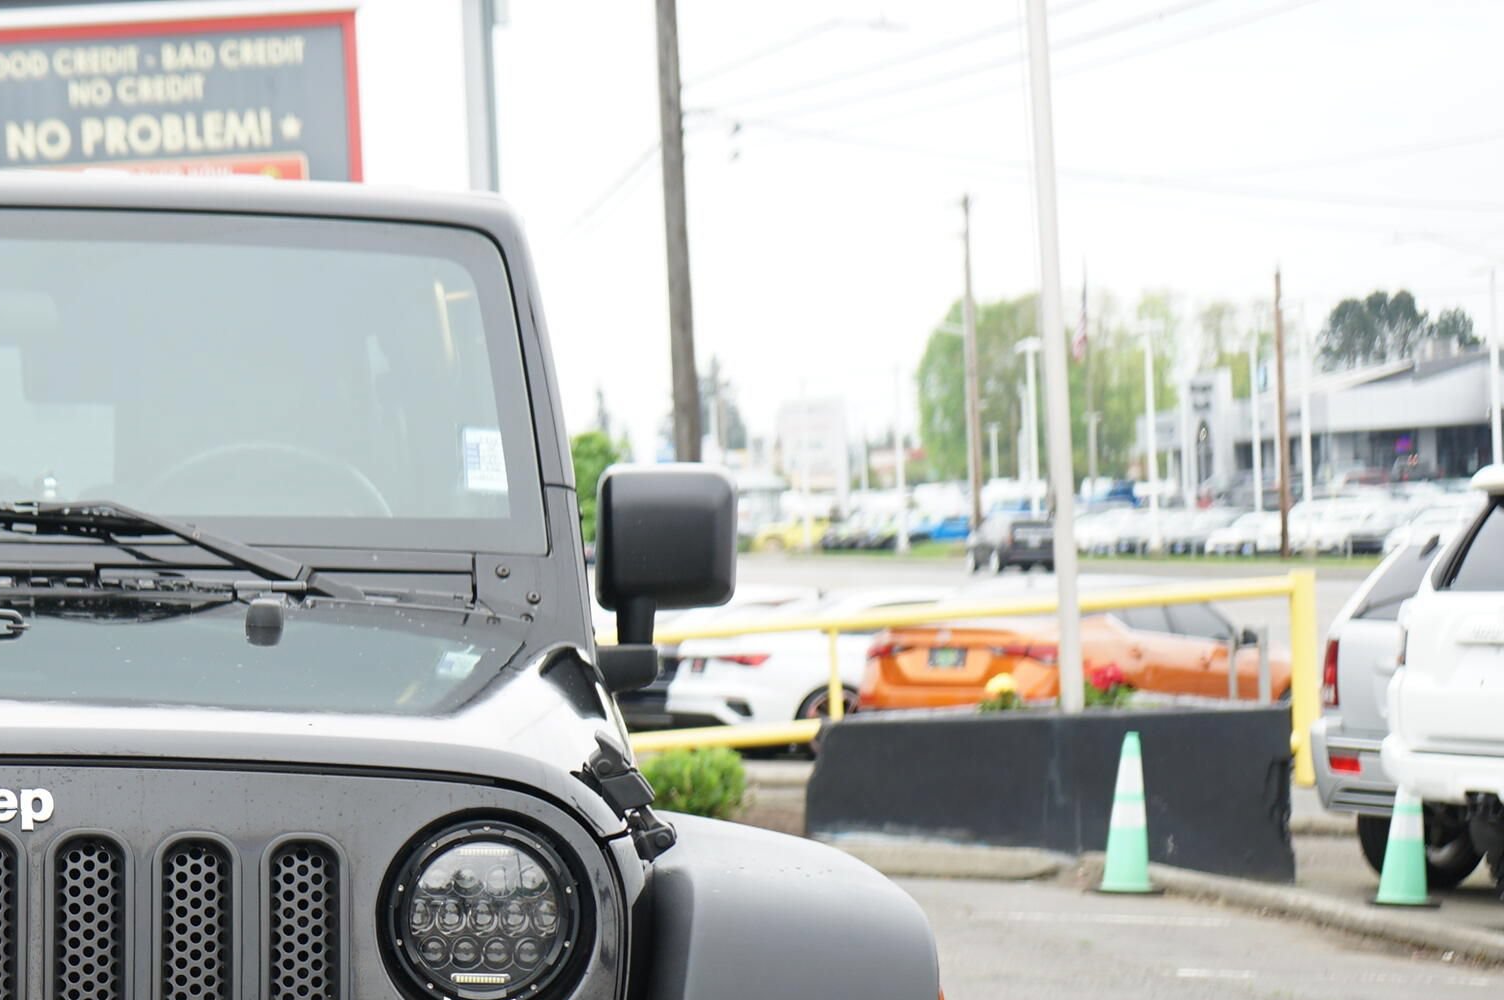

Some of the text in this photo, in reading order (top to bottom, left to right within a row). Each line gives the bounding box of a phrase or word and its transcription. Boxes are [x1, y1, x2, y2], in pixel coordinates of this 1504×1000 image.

[52, 44, 139, 77] CREDIT
[161, 40, 215, 71] BAD
[219, 35, 305, 70] CREDIT
[67, 72, 205, 108] NO CREDIT
[5, 107, 273, 160] NO PROBLEM!
